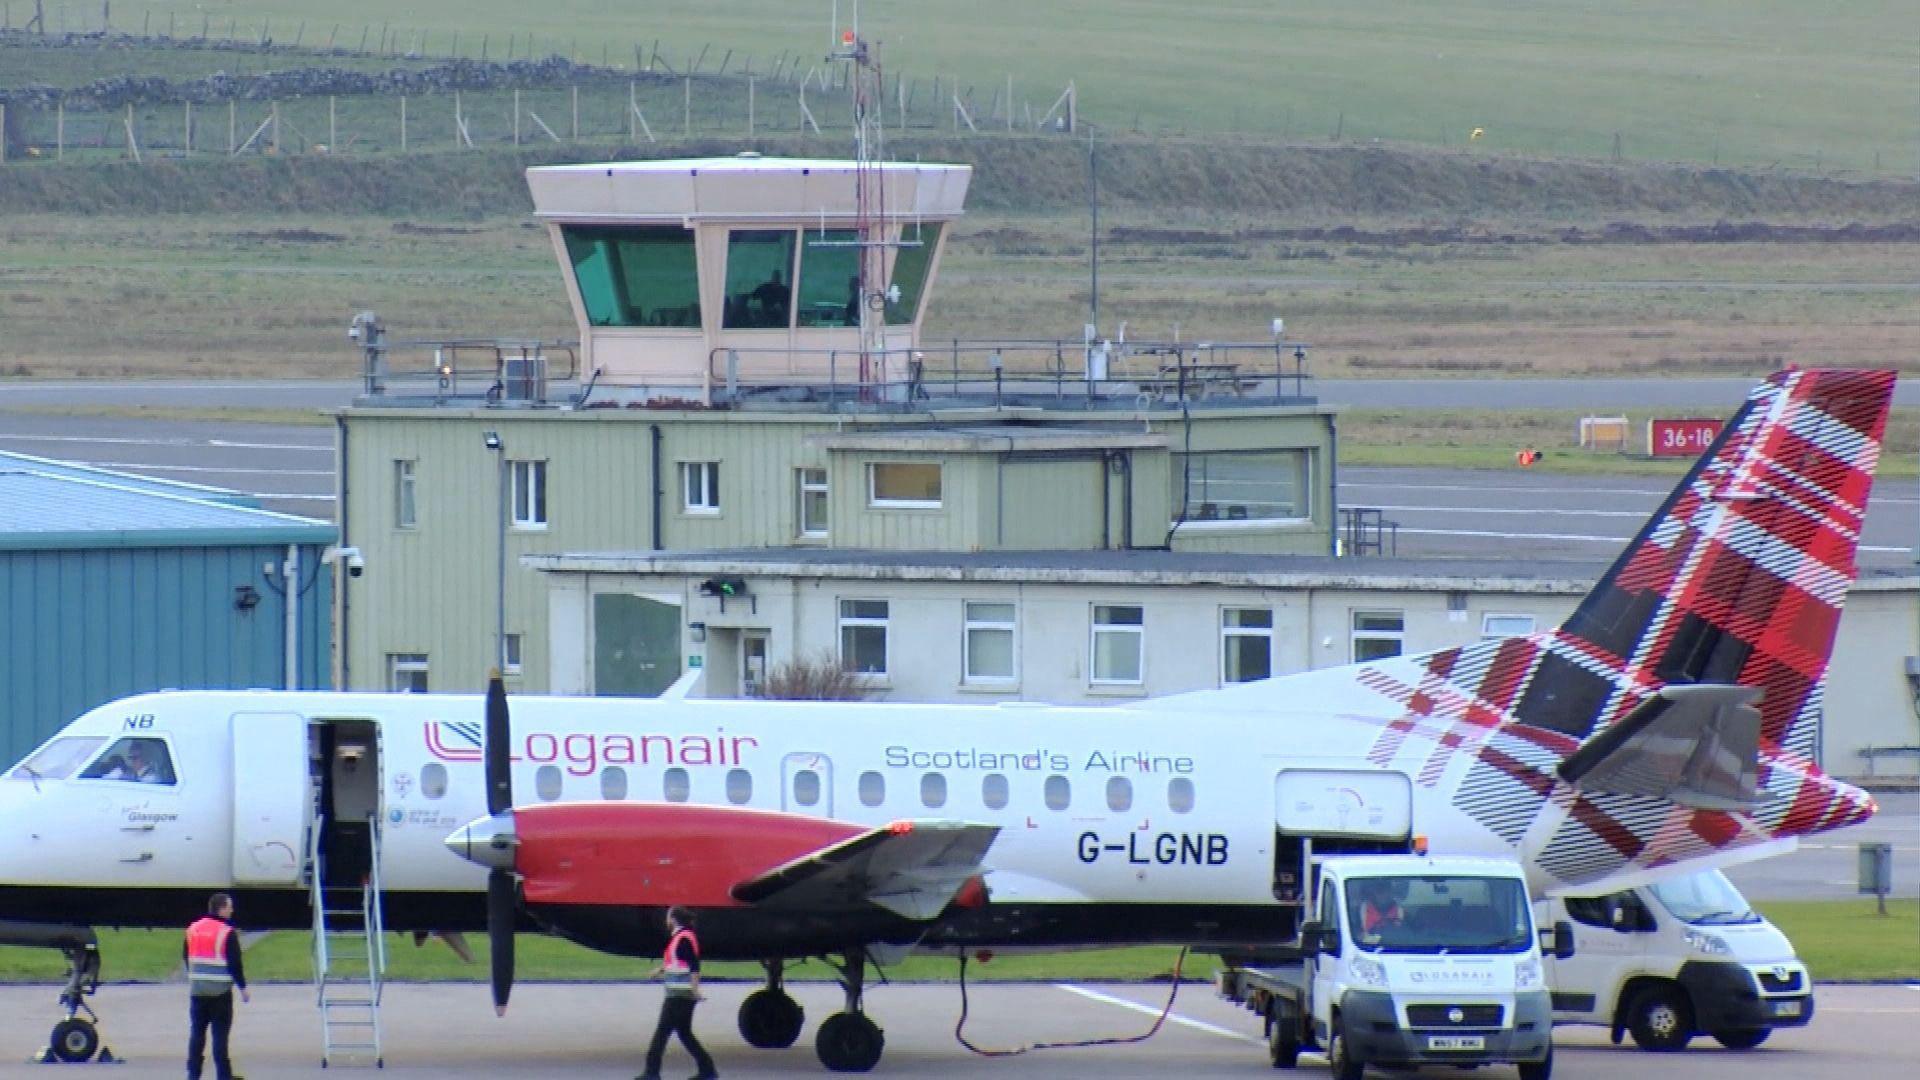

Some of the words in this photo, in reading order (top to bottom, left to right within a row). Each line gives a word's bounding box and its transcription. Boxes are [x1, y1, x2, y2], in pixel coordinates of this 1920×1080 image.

[1663, 427, 1714, 448] 36-18
[121, 713, 155, 731] NB
[511, 726, 758, 777] oganair
[885, 745, 1069, 772] Scotland's
[1085, 749, 1194, 773] Airline
[128, 810, 178, 824] Glasgow
[1078, 831, 1230, 865] G-LGNB
